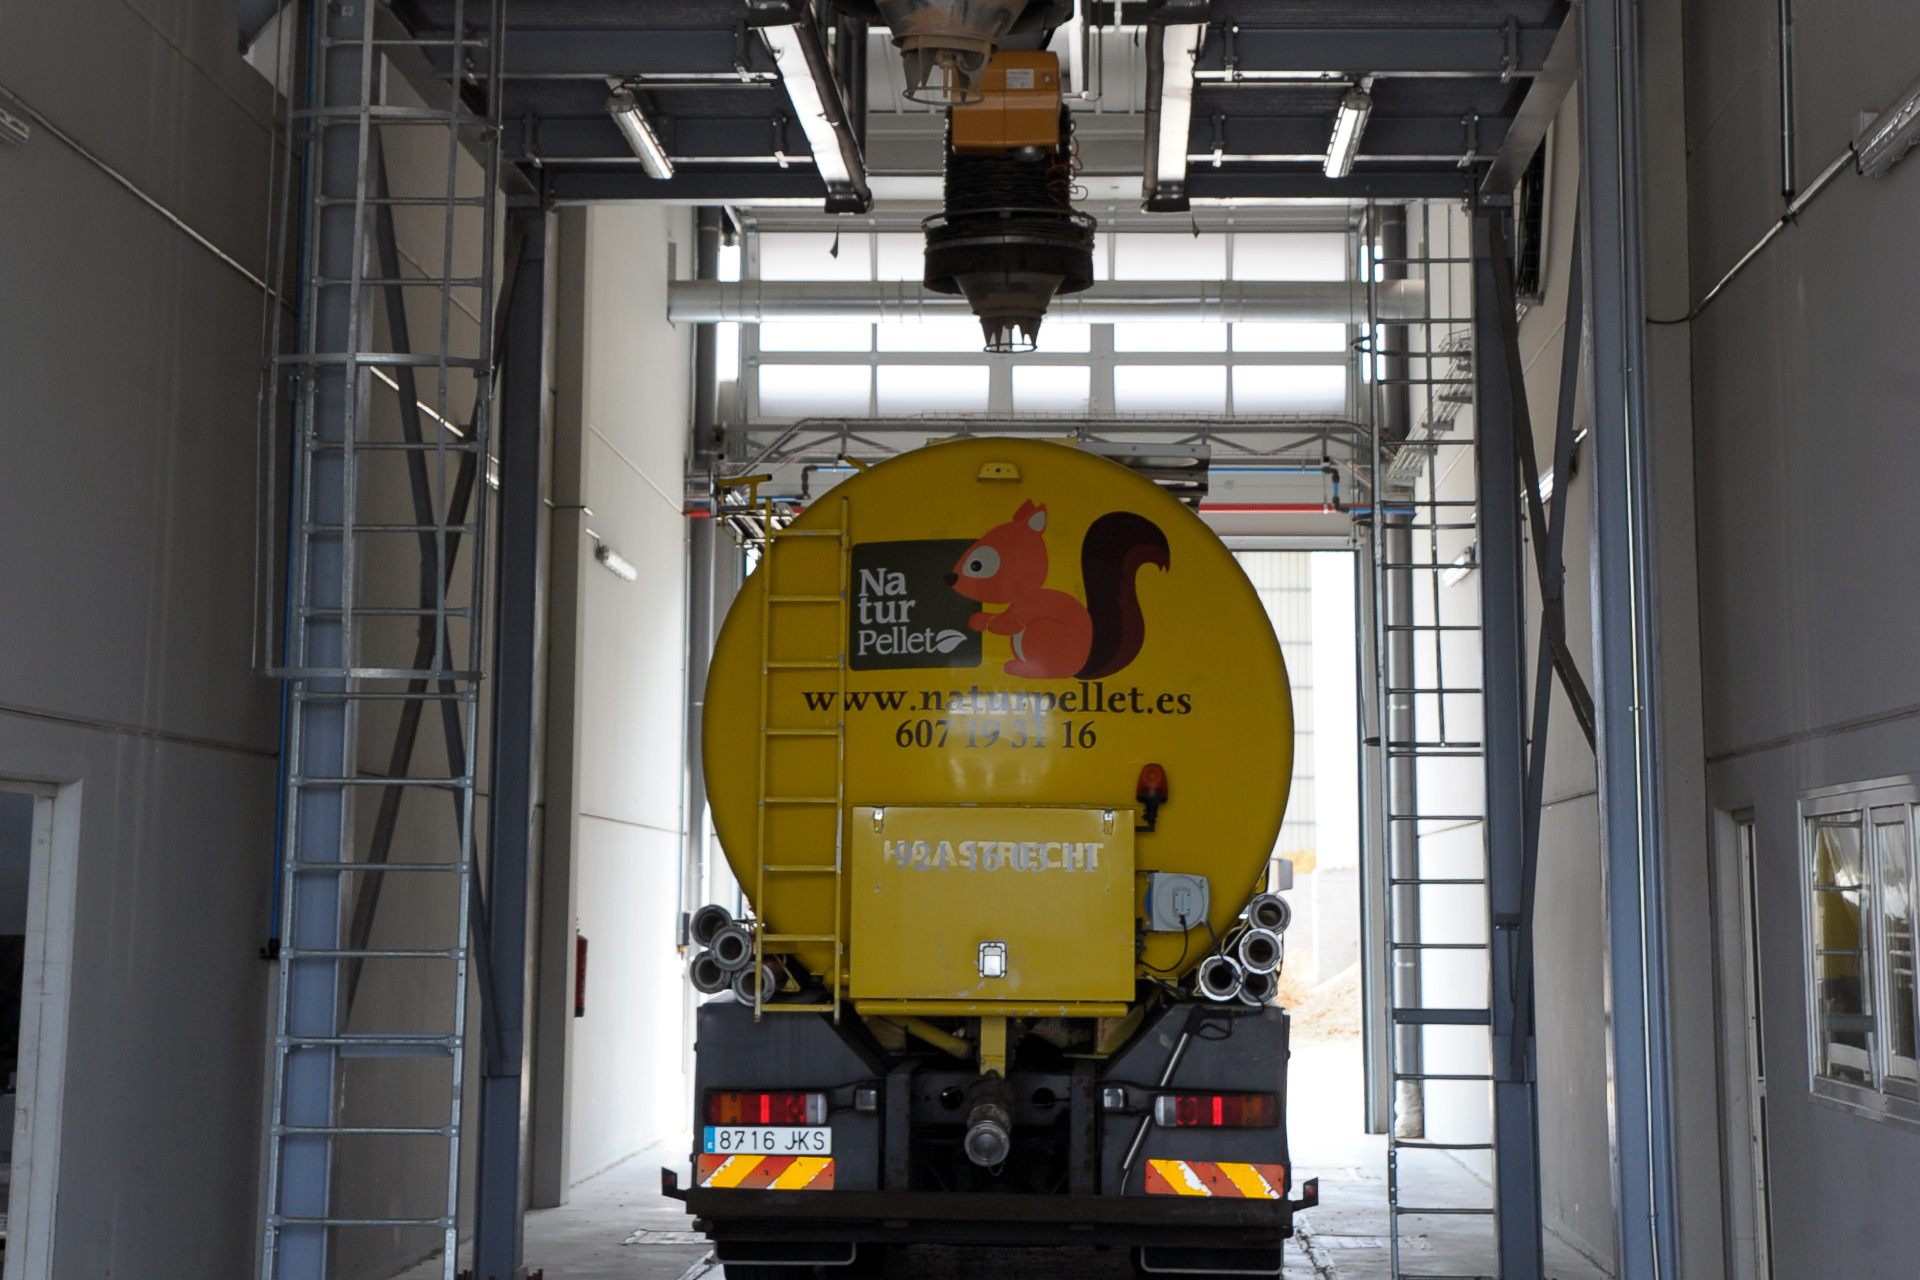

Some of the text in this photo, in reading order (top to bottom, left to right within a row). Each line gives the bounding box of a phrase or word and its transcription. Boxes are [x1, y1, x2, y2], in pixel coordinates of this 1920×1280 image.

[858, 567, 907, 597] Na
[858, 596, 916, 625] tur
[857, 626, 936, 656] Pellet
[802, 681, 1192, 719] www.naturpellet.es
[895, 719, 1097, 749] 607 19 31 16
[894, 842, 1097, 873] 921 16 03 11
[720, 1131, 775, 1151] 8716
[785, 1131, 825, 1151] JKS
